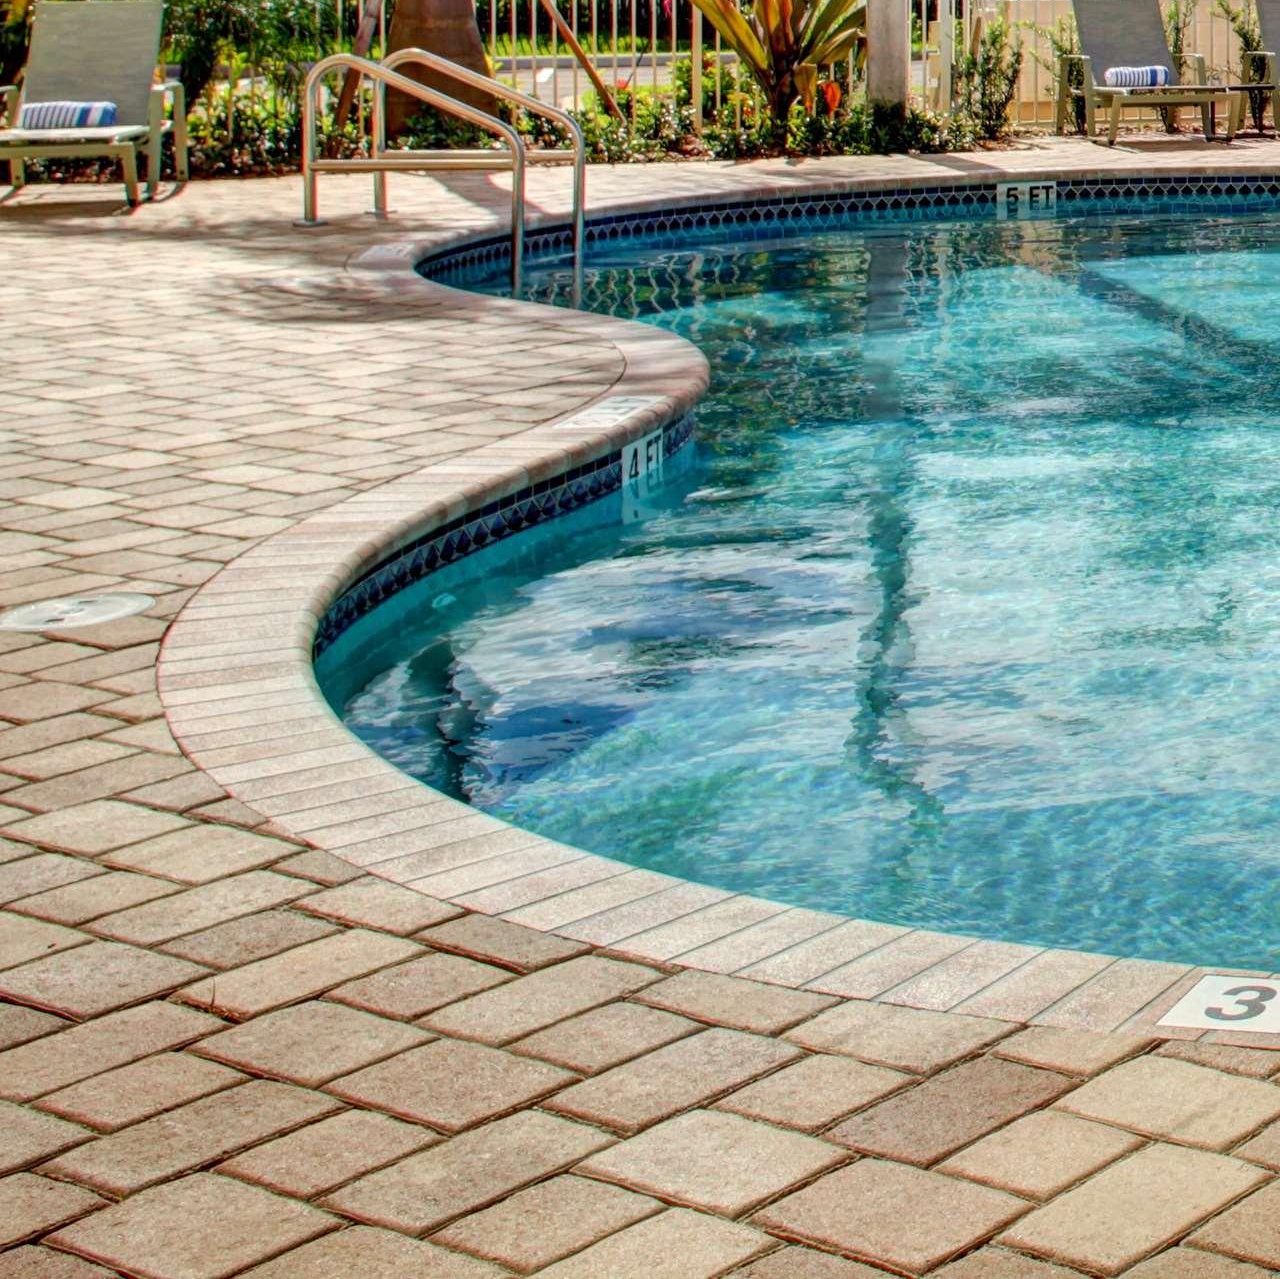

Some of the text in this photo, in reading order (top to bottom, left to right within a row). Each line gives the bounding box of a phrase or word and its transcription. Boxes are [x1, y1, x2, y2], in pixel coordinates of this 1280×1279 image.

[1006, 186, 1019, 206] 5
[629, 434, 662, 479] 4 FT
[1204, 985, 1278, 1021] 3
